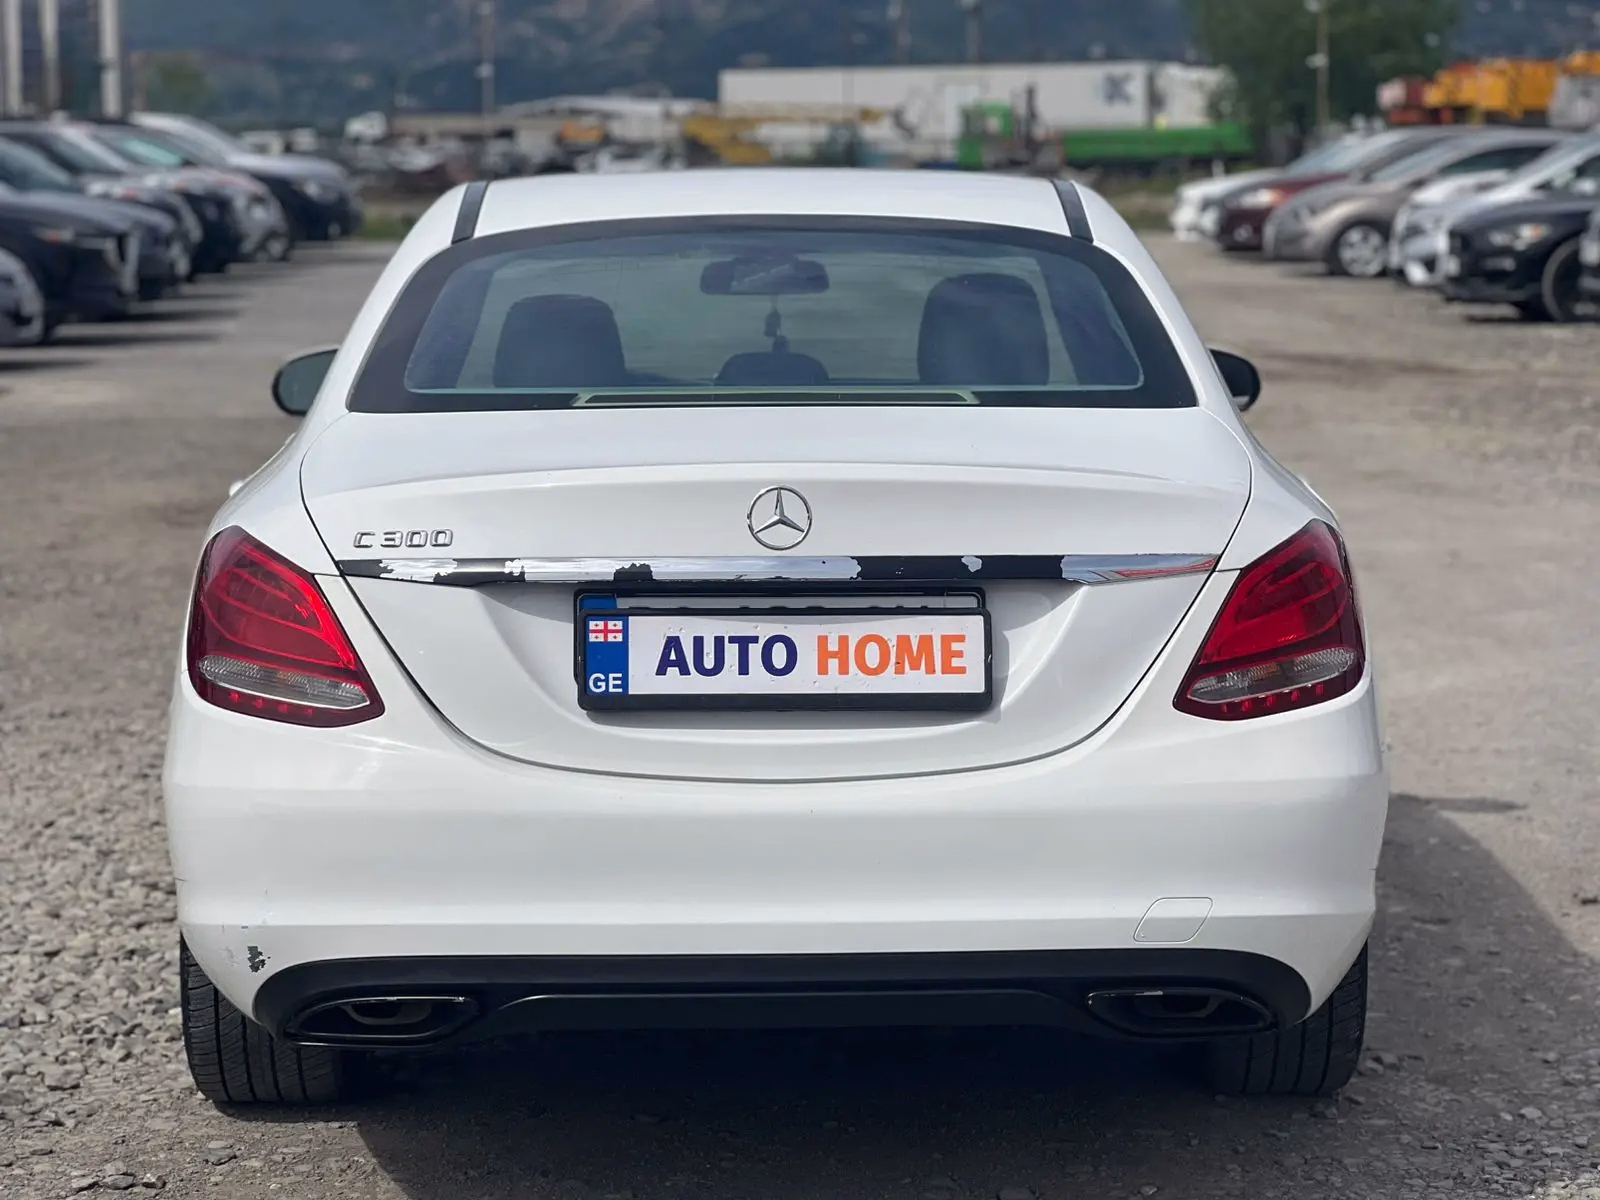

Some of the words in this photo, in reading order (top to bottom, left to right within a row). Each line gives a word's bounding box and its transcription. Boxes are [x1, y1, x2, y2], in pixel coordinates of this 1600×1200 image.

[655, 635, 799, 676] AUTO
[817, 634, 967, 676] HOME
[588, 673, 623, 693] GE
